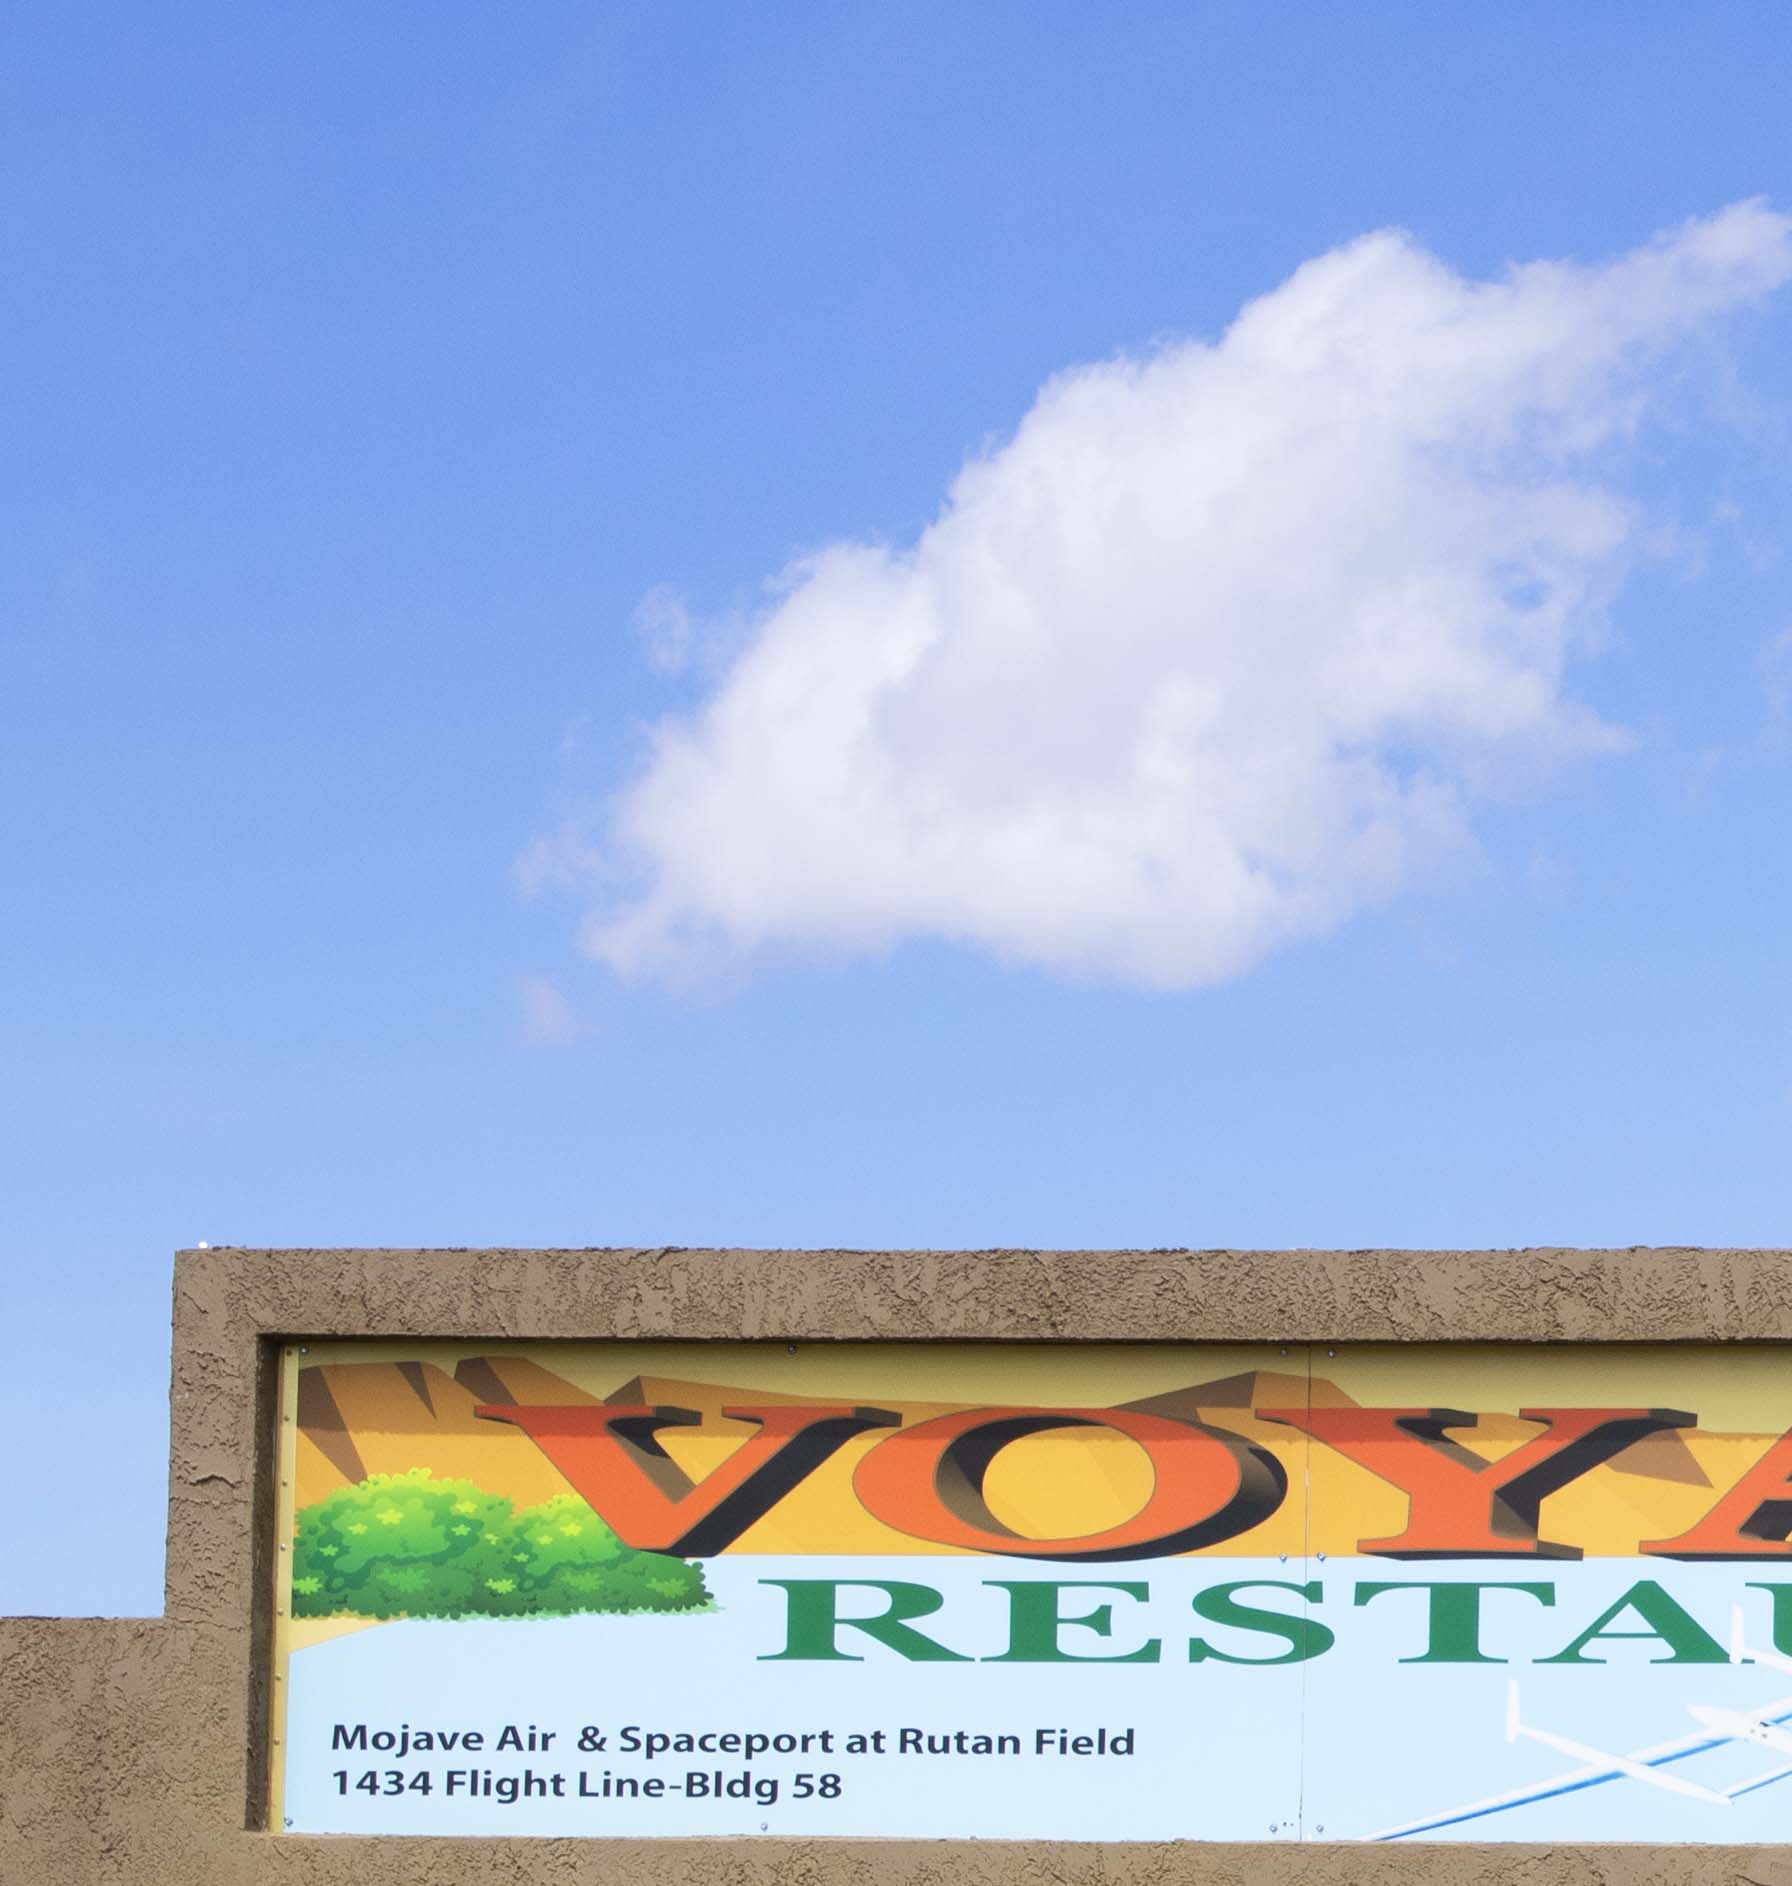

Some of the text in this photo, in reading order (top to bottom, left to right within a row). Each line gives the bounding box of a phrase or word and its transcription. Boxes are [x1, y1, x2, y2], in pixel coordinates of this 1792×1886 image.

[331, 1724, 1136, 1761] Mojave Air & Spaceport at Rutan Field
[332, 1769, 843, 1806] 1434 Flight Line-Bldg 58
